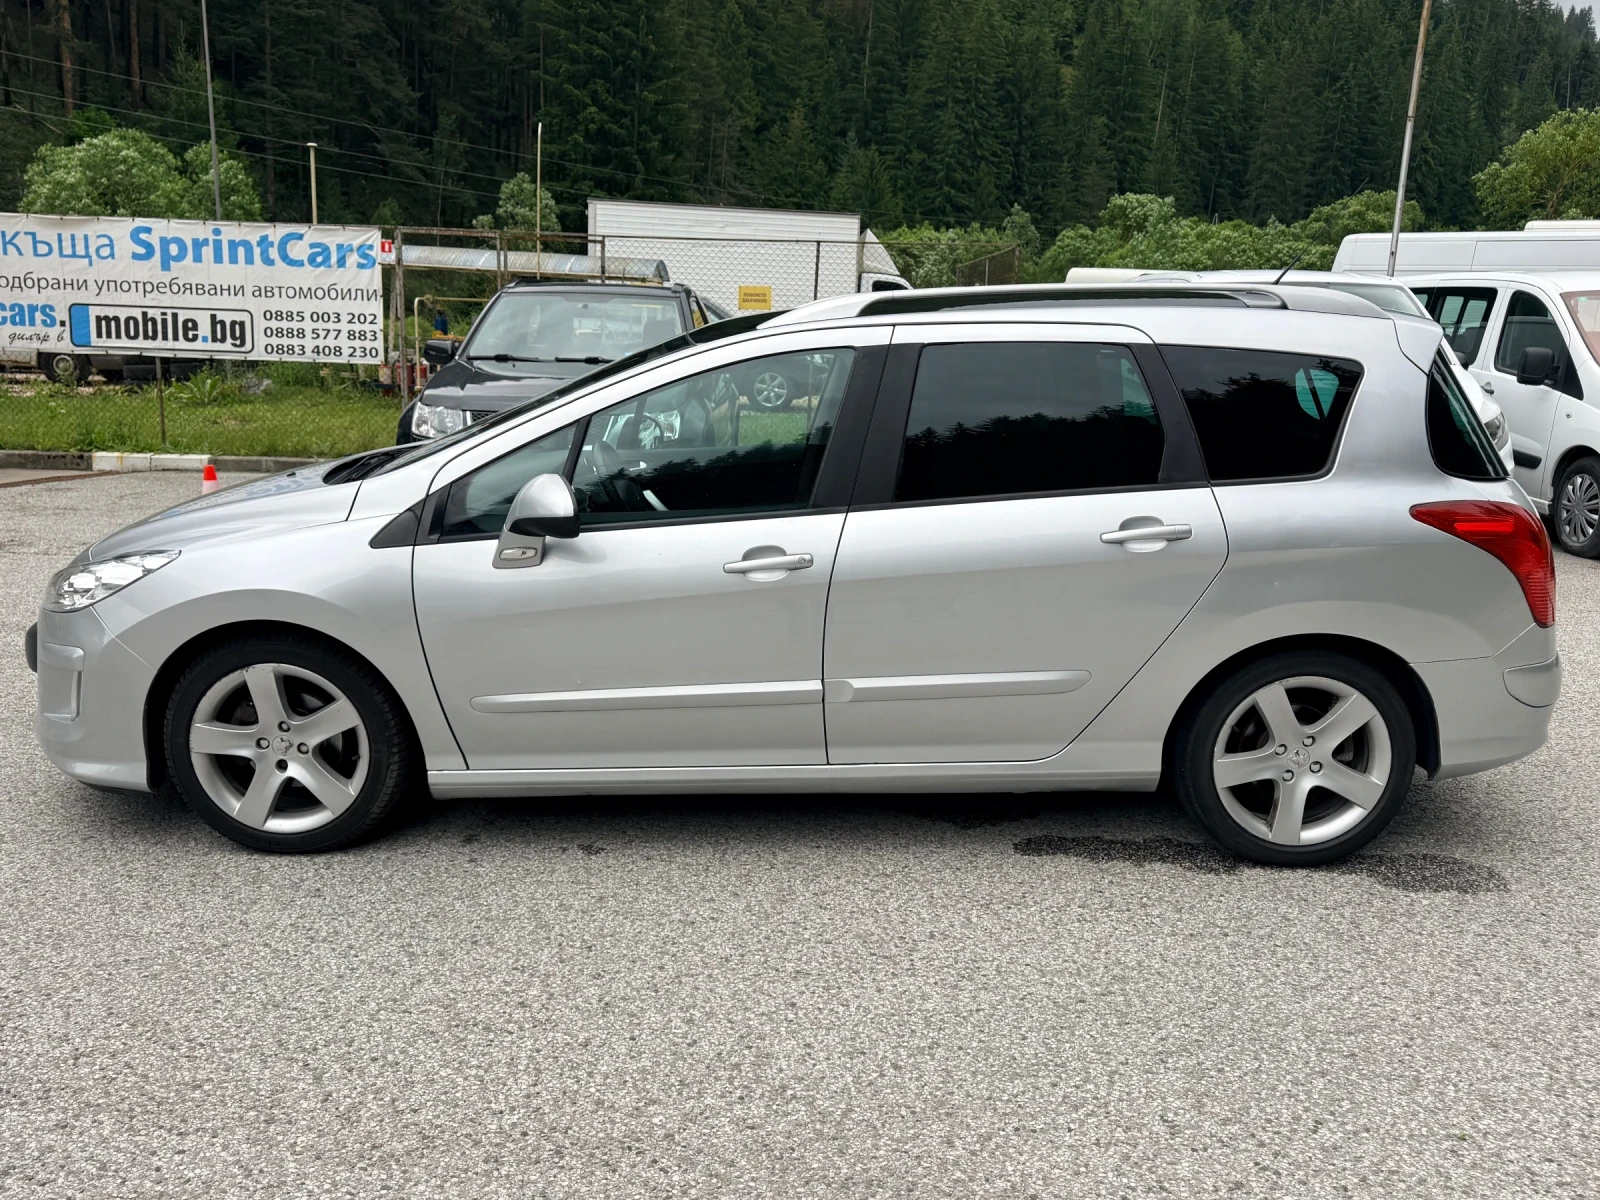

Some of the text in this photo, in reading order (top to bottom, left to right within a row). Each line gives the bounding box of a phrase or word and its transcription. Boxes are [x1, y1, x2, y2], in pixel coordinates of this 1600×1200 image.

[1, 225, 377, 272] къща SprintCars
[0, 271, 378, 301] одбрани употребявани автомобили
[263, 310, 378, 324] 0885 003 202
[95, 311, 246, 348] mobile.bg
[264, 327, 378, 341] 0888 577 883
[264, 344, 379, 358] 0883 408 230
